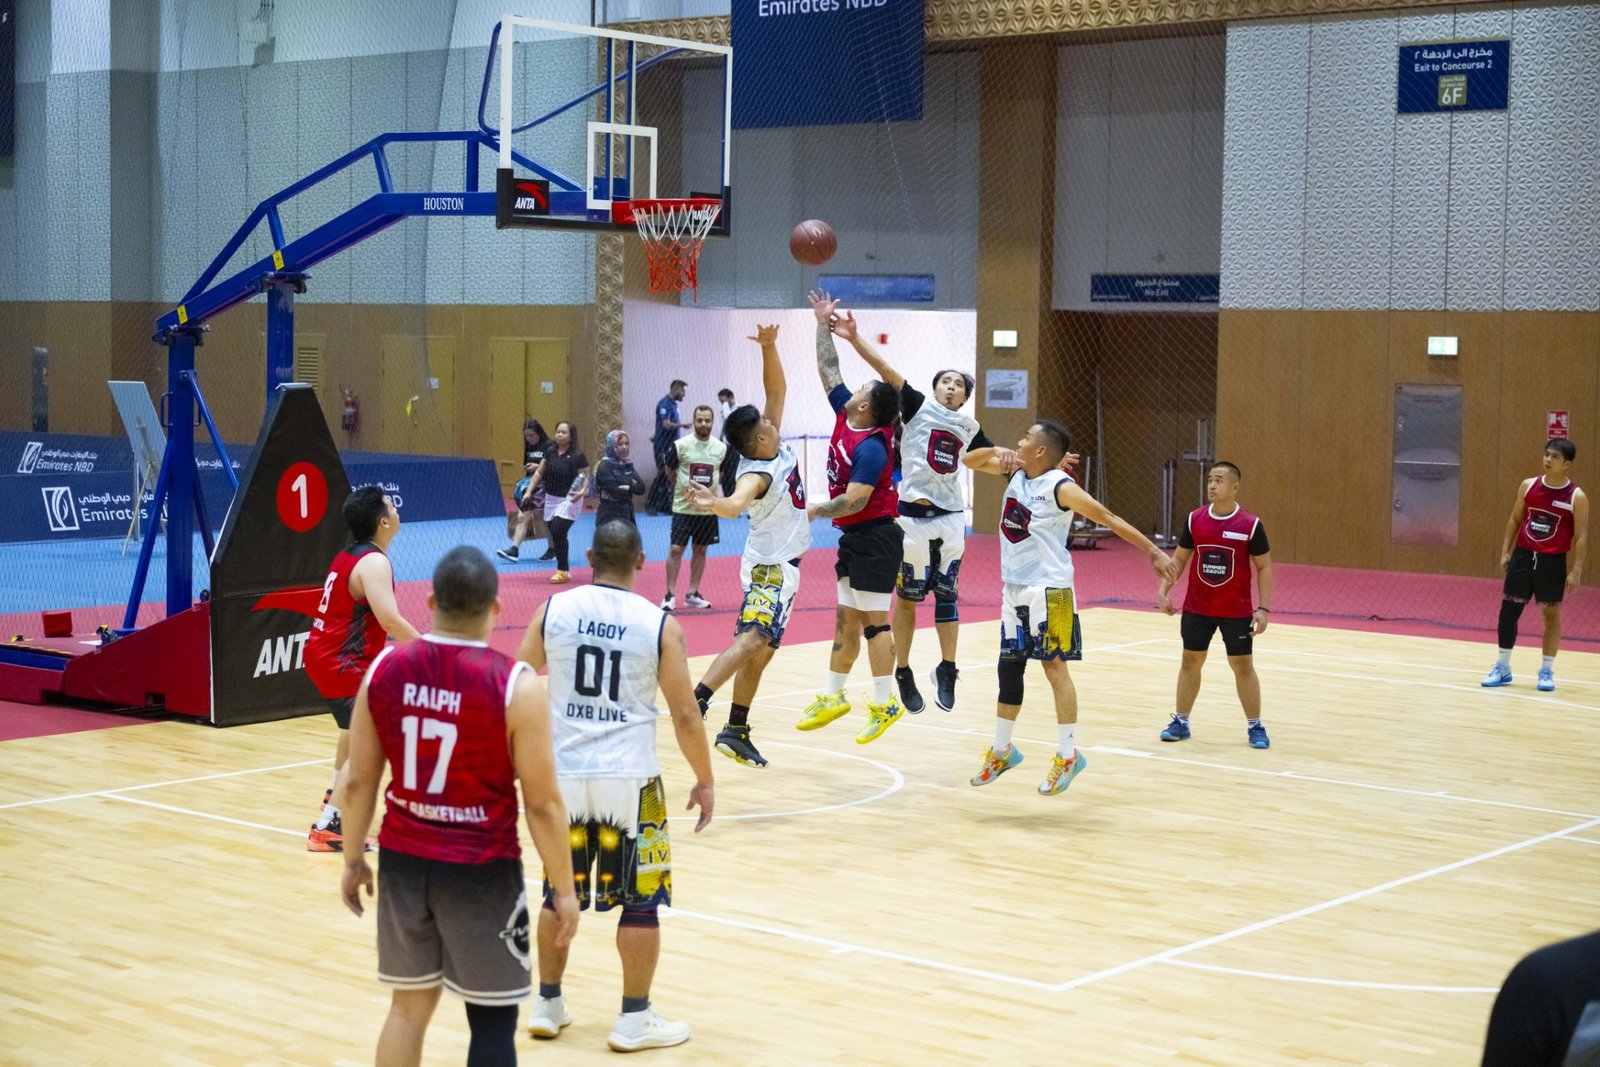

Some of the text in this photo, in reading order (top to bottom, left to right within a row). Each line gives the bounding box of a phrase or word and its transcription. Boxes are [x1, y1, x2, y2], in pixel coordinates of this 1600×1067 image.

[759, 0, 839, 17] Emirates
[1469, 47, 1493, 59] مخرج
[1414, 59, 1493, 73] Exit to Concourse 2
[1442, 87, 1463, 105] 6F
[423, 197, 464, 211] HOUSTON
[514, 196, 536, 210] ANTA
[36, 458, 95, 473] Emirates NBD
[291, 473, 308, 519] 1
[578, 618, 627, 641] LAGOY
[252, 630, 312, 679] ANT
[574, 643, 623, 702] 01
[403, 682, 462, 715] RALPH
[566, 702, 628, 723] DXB LIVE
[401, 714, 459, 795] 17
[409, 800, 489, 824] BASKETBALL
